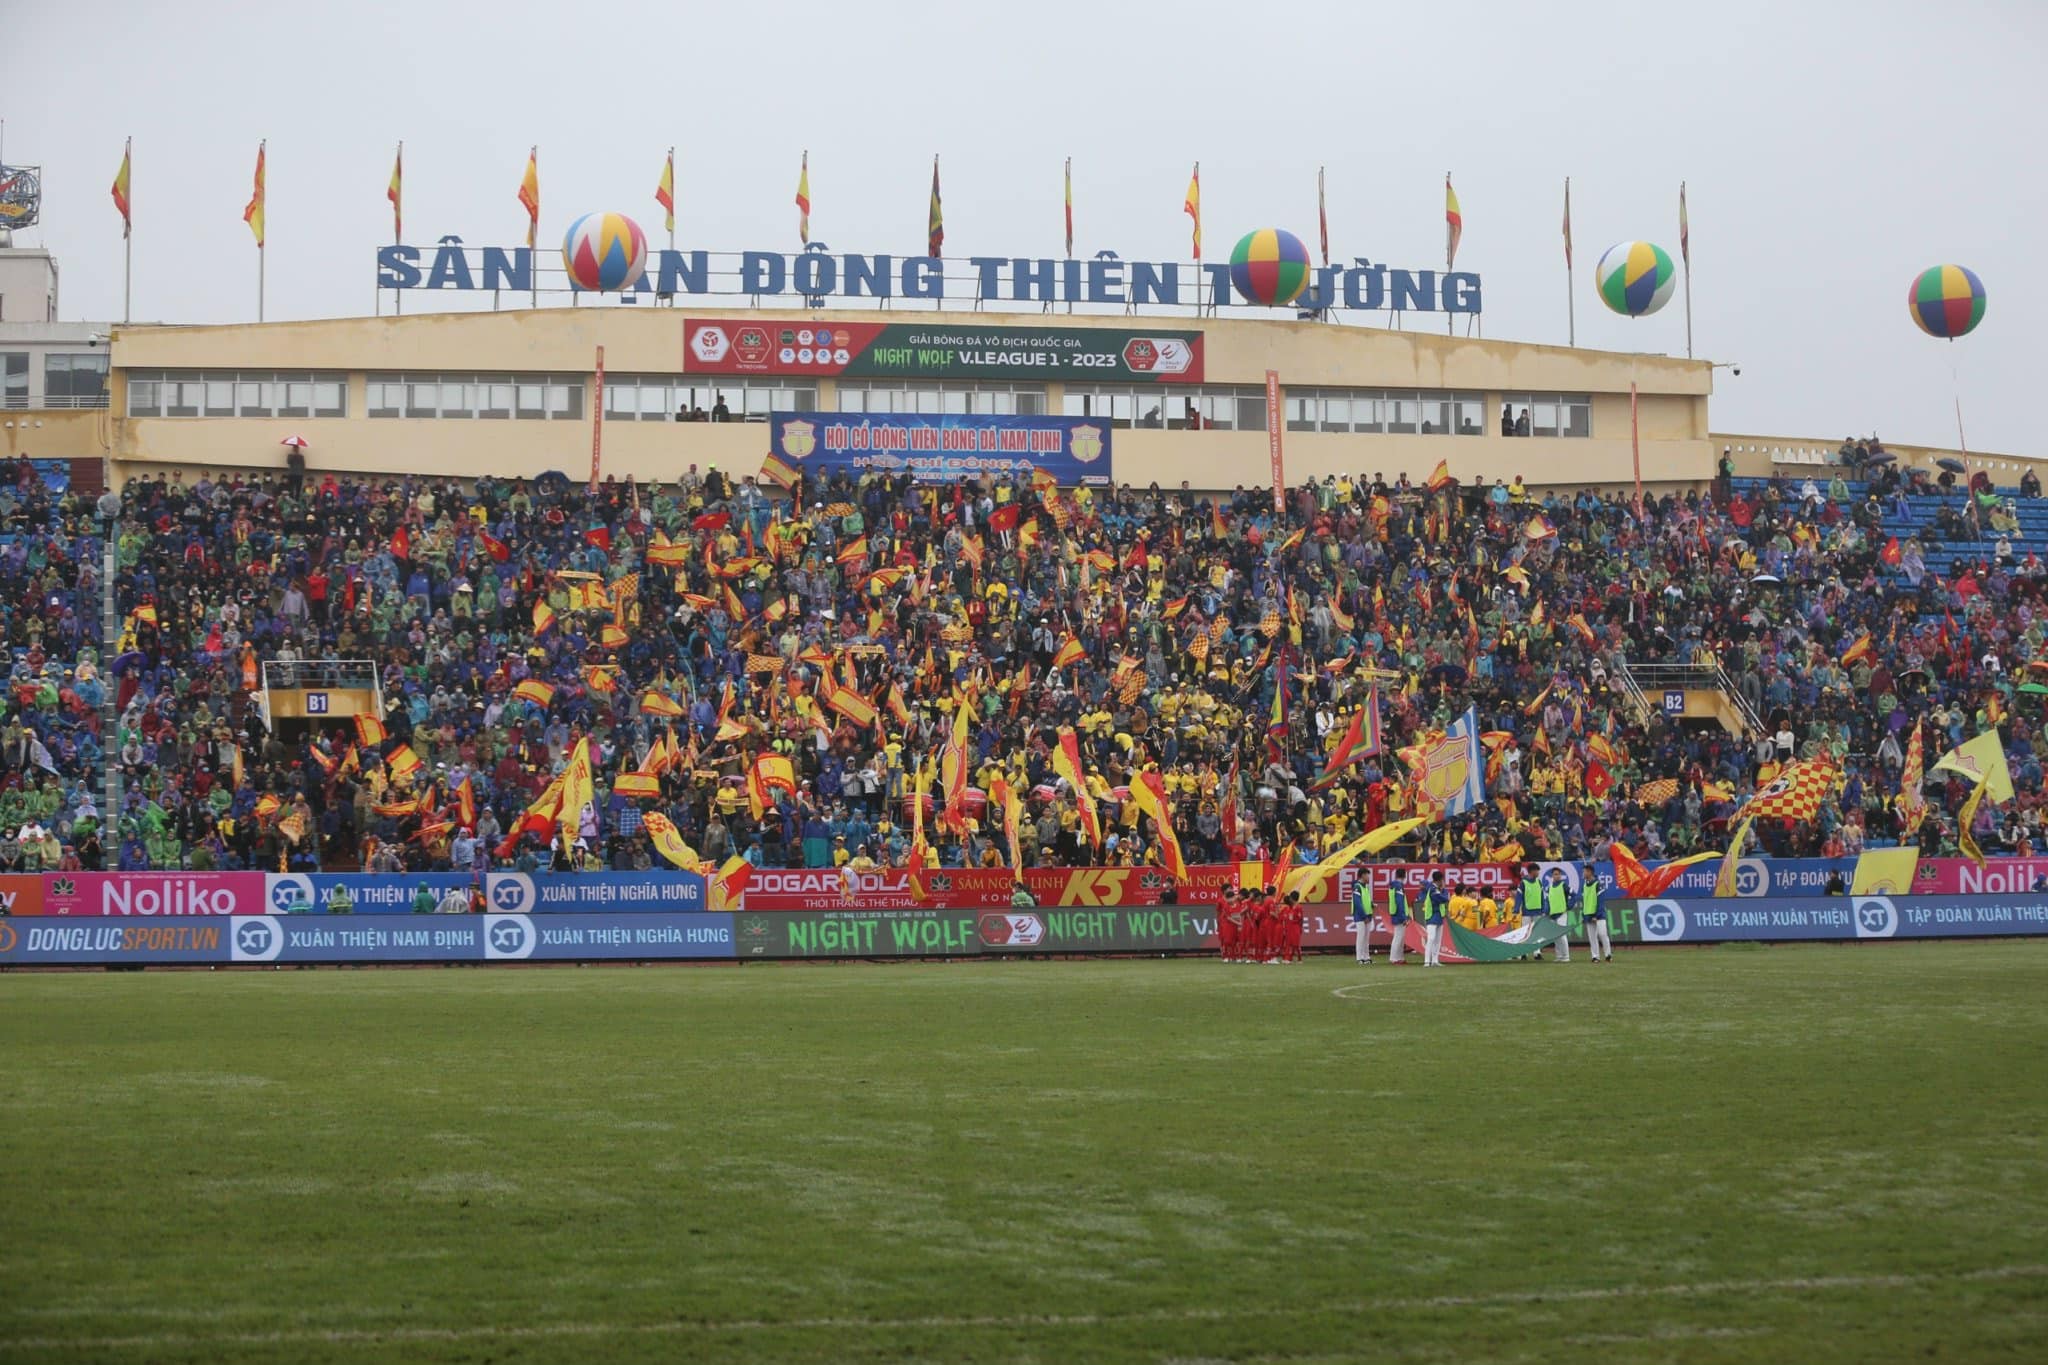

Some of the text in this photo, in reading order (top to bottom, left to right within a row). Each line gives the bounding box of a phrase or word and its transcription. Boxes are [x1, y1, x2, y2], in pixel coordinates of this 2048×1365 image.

[377, 235, 531, 291] SÂN
[740, 242, 945, 307] ĐỘNG
[970, 250, 1178, 305] THIÊN
[1203, 257, 1482, 313] TƯỜNG
[909, 334, 932, 345] GIẢI
[933, 335, 964, 346] BÓNG
[966, 336, 982, 346] ĐÁ
[1002, 337, 1029, 348] ĐỊCH
[1031, 336, 1061, 348] QUỐC
[1063, 340, 1082, 348] GIA
[874, 348, 912, 367] NIGHT
[917, 350, 954, 370] WOLF
[959, 351, 1047, 366] V.LEAGUE
[1050, 352, 1060, 366] 1
[1072, 353, 1117, 367] 2023
[824, 419, 1062, 457] HỘI CỔ ĐỘNG VIÊN BÓNG ĐÁ NAM ĐỊNH
[905, 455, 944, 468] KHÍ
[308, 695, 327, 711] B1
[1665, 695, 1683, 710] B2
[745, 874, 911, 892] JOGAROLA
[958, 874, 984, 889] SÂM
[1031, 877, 1064, 889] LINH
[1058, 869, 1129, 906] K5
[1775, 869, 1797, 889] TẬP
[1960, 864, 2048, 894] Nolik
[103, 880, 236, 916] Noliko
[363, 884, 402, 906] THIỆN
[542, 882, 697, 904] XUÂN THIỆN NGHĨA HƯNG
[831, 898, 865, 908] TRANG
[1647, 911, 1672, 929] XT
[1694, 907, 1849, 929] THÉP XANH XUÂN THIỆN
[1861, 909, 1885, 926] XT
[1906, 907, 1931, 925] TẬP
[1936, 905, 1973, 923] ĐOÀN
[1977, 903, 2013, 922] XUÂN
[493, 927, 521, 946] XT
[542, 926, 583, 945] XUÂN
[587, 925, 632, 947] THIỆN
[636, 926, 683, 944] NGHĨA
[687, 926, 729, 943] HƯNG
[788, 919, 975, 953] NIGHT WOLF
[1049, 911, 1117, 941] NIGHT
[1128, 911, 1191, 940] WOLF
[27, 927, 220, 951] DONGLUCSPORT.VN
[241, 929, 269, 948] XT
[290, 927, 475, 950] XUÂN THIỆN NAM ĐỊNH
